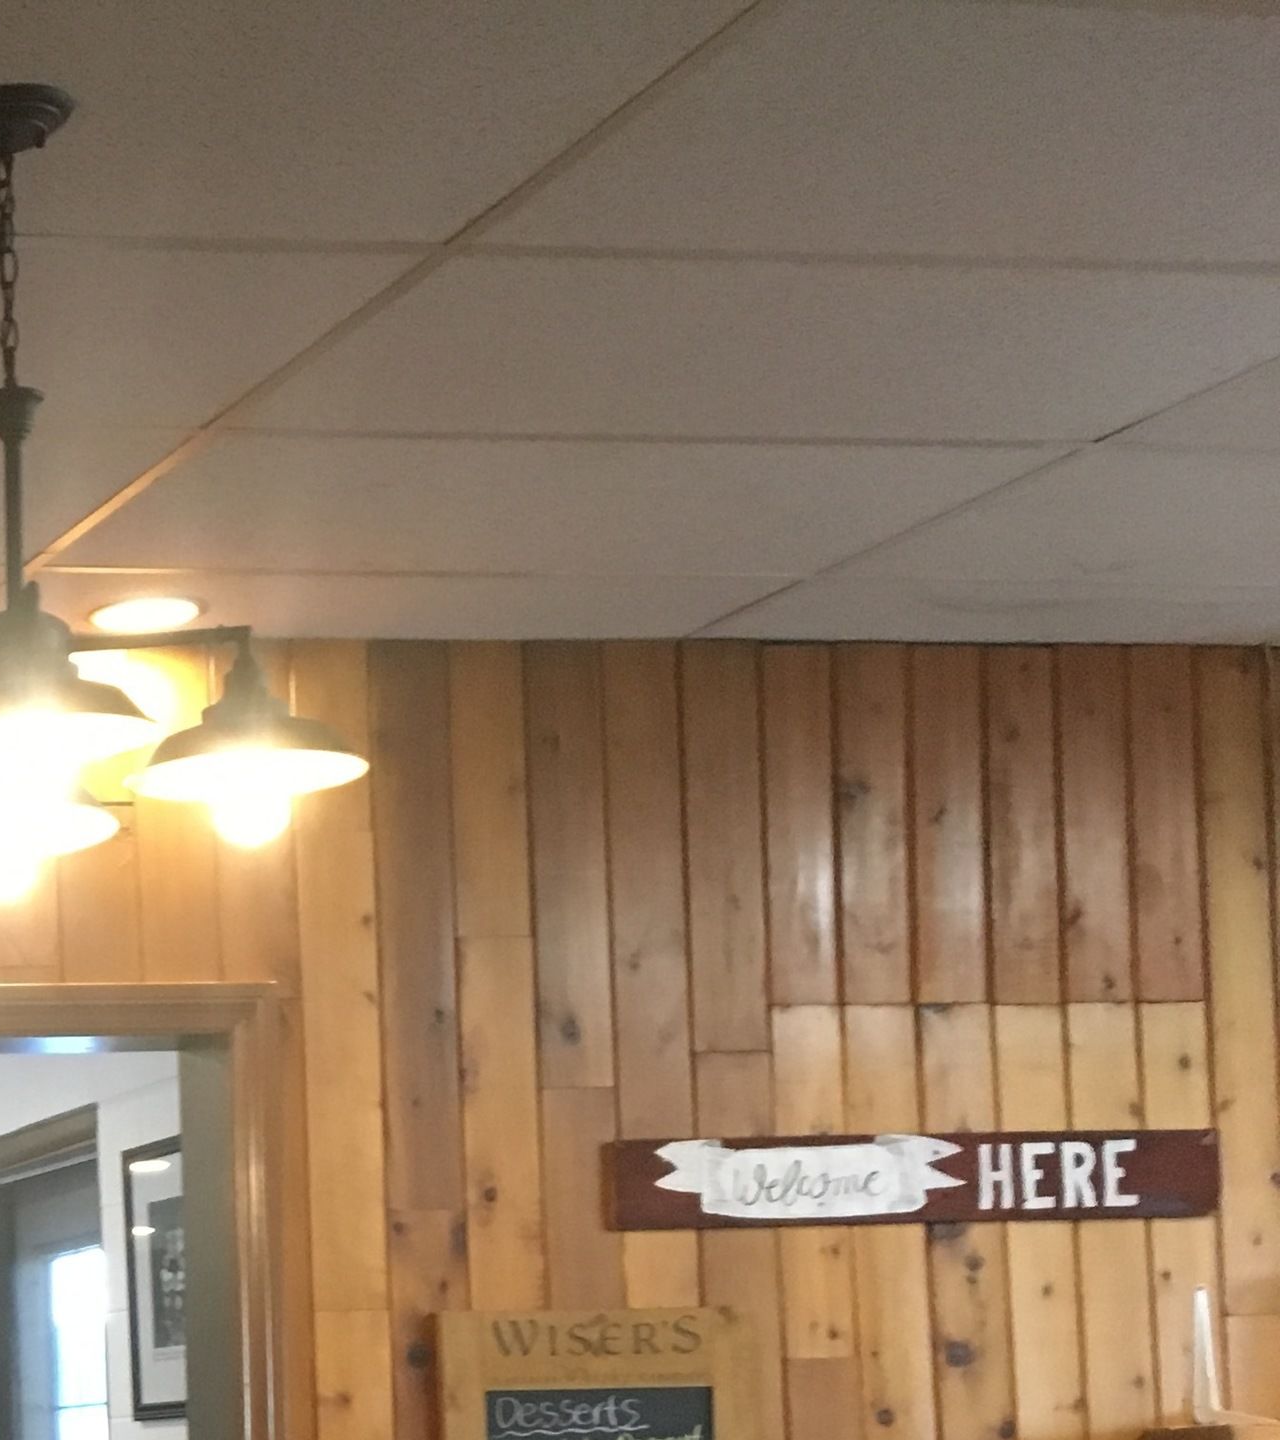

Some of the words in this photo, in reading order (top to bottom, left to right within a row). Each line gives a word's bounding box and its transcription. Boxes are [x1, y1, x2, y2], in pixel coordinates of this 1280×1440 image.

[733, 1160, 883, 1206] Welcome
[977, 1139, 1140, 1210] HERE
[495, 1396, 642, 1428] Desserts
